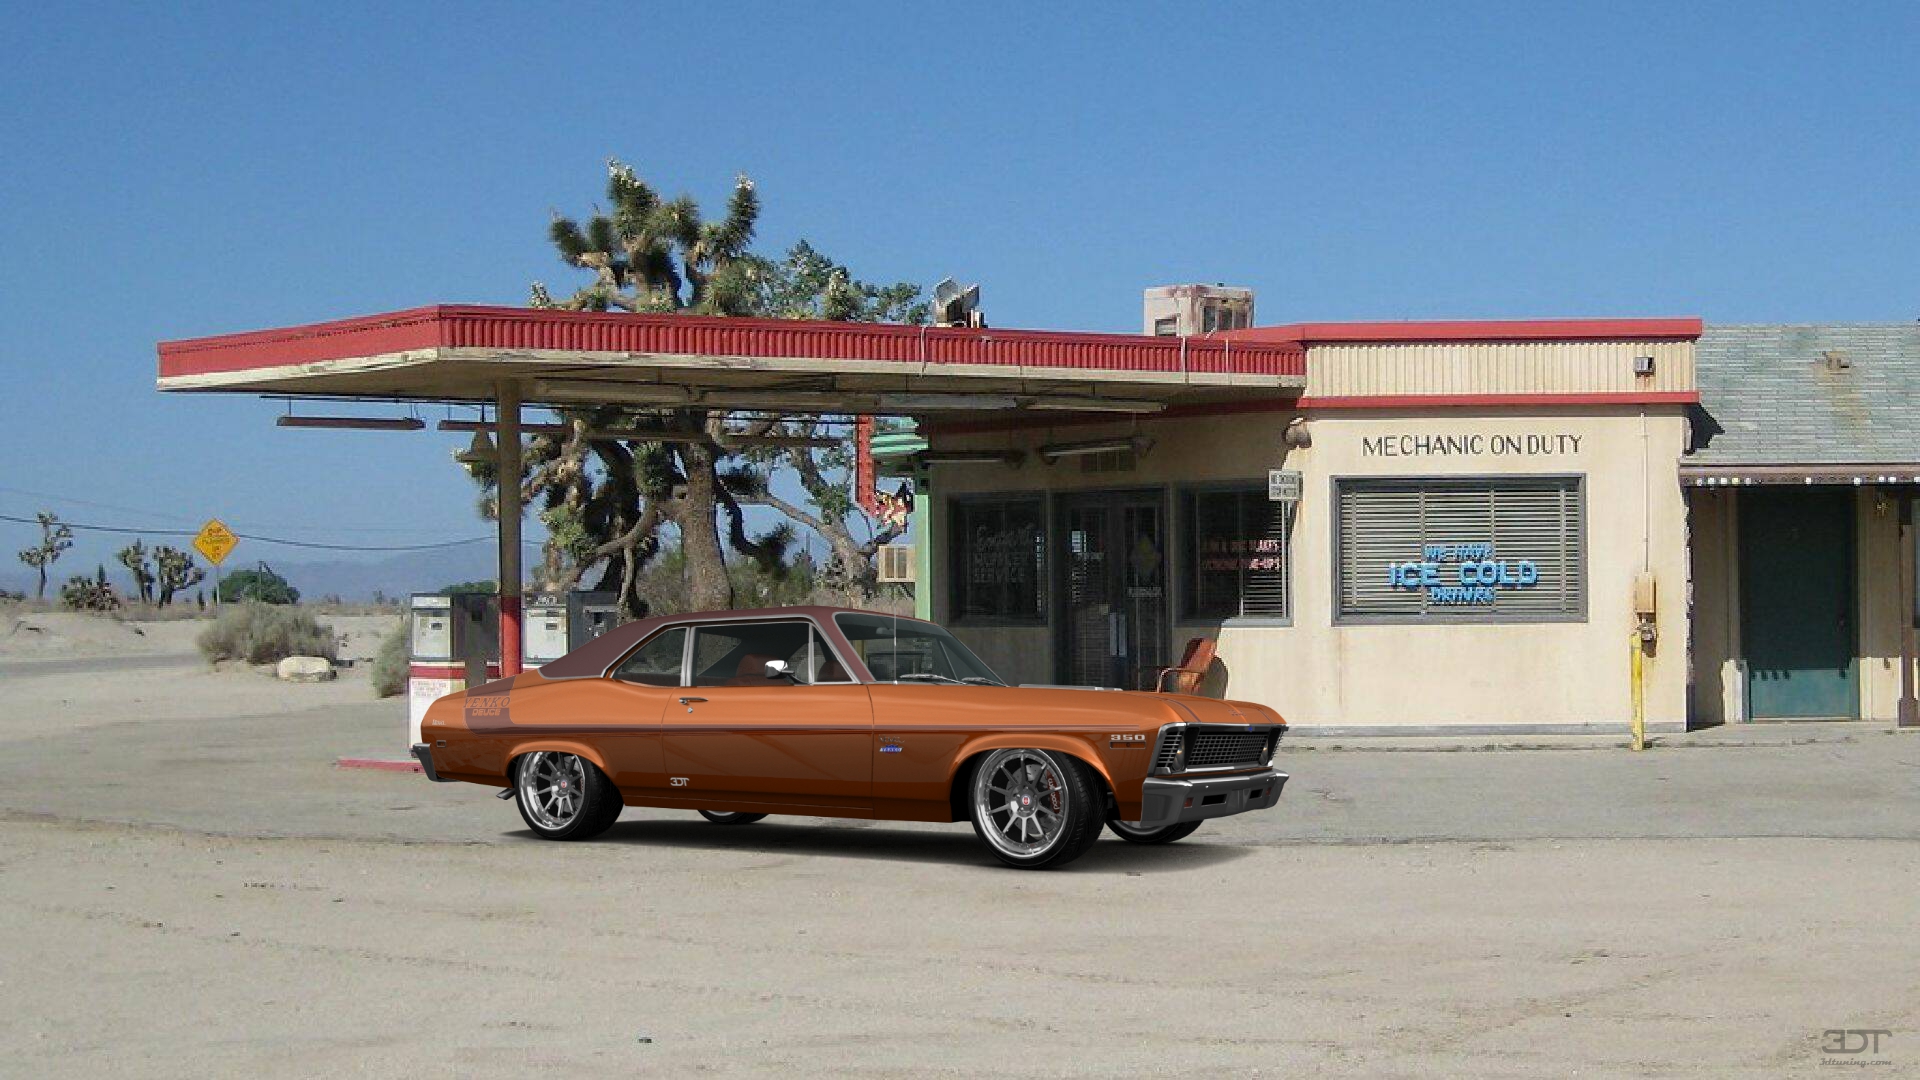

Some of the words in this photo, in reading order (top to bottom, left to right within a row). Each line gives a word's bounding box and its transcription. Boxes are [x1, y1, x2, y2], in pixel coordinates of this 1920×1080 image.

[1362, 434, 1484, 457] MECHANIC
[1490, 434, 1522, 456] ON
[1527, 434, 1583, 455] DUTY
[1389, 562, 1441, 586] ICE
[1461, 560, 1539, 586] COLD
[463, 696, 511, 708] YENKO
[471, 708, 501, 717] DEUCE
[670, 776, 690, 787] 3DT
